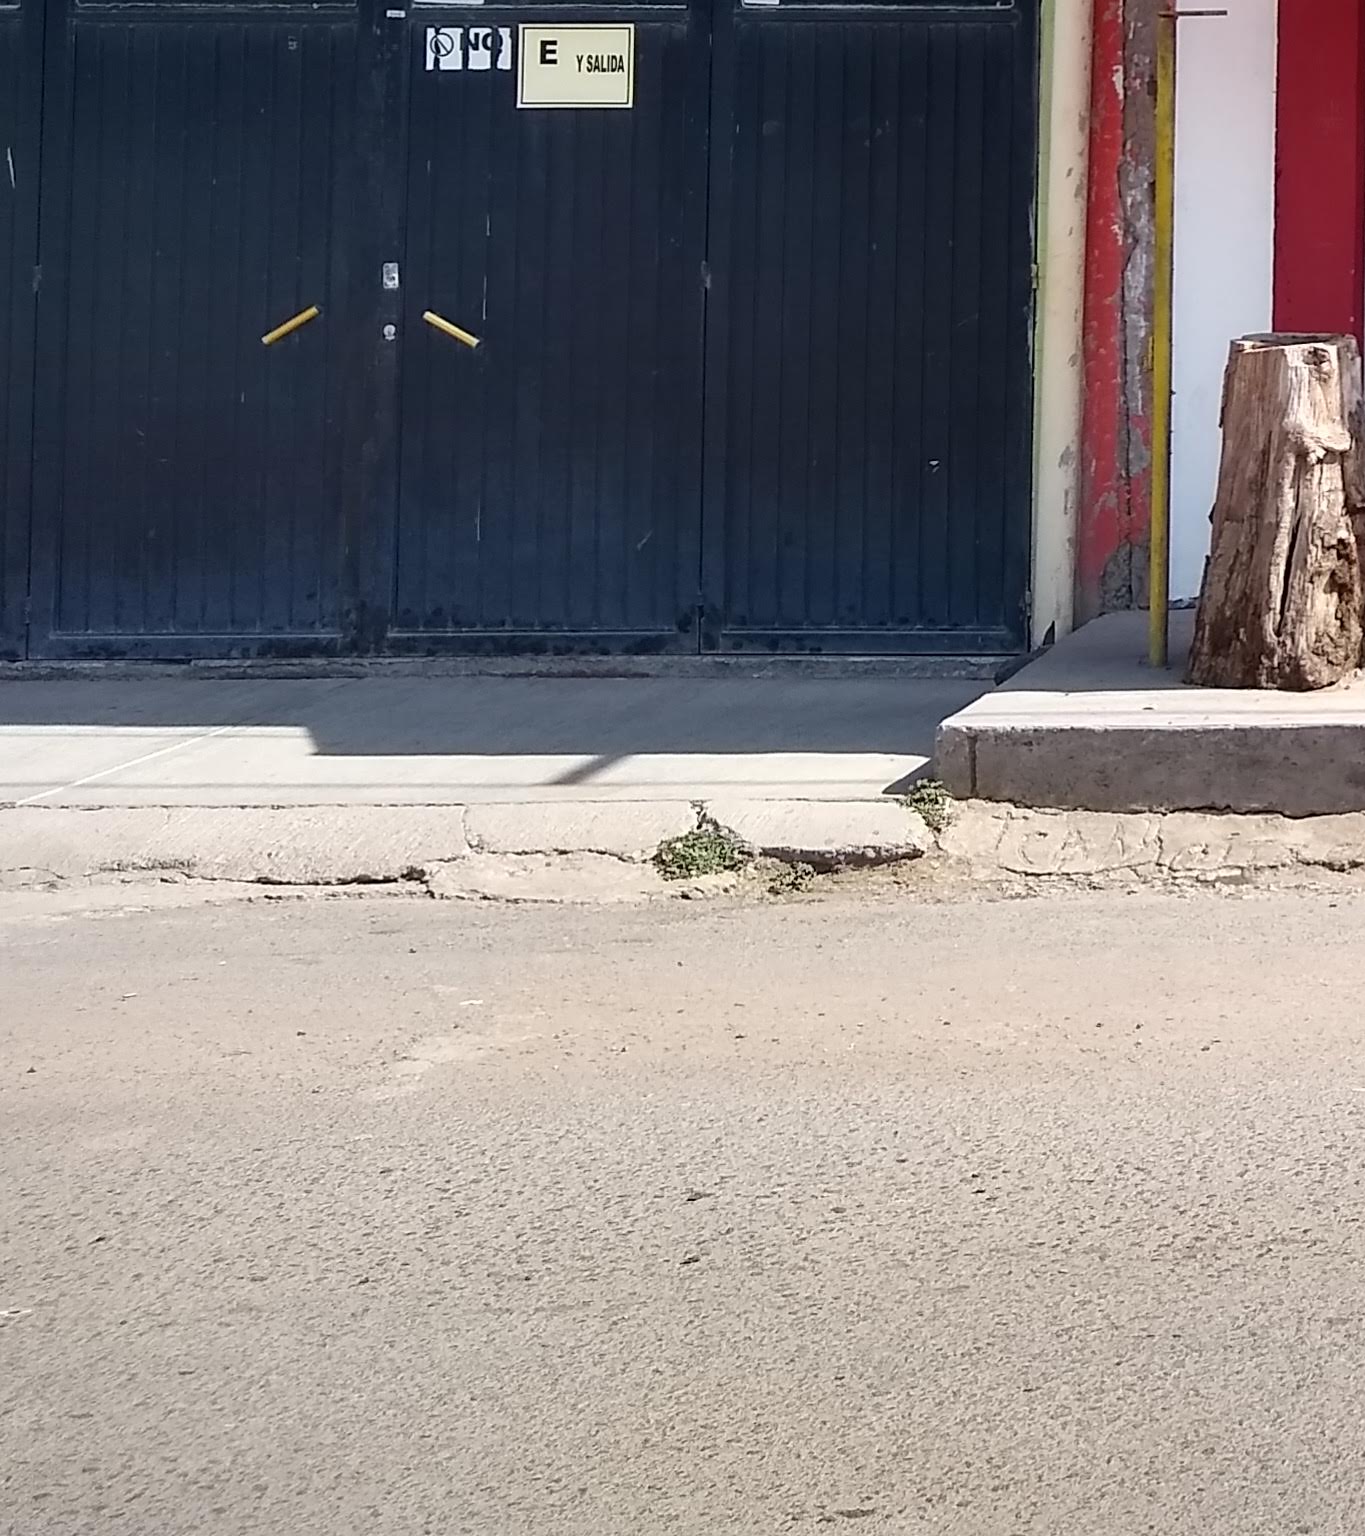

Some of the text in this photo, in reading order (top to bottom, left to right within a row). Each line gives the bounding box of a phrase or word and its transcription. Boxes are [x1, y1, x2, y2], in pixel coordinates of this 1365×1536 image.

[540, 40, 557, 64] E
[577, 55, 625, 72] Y SALIDA
